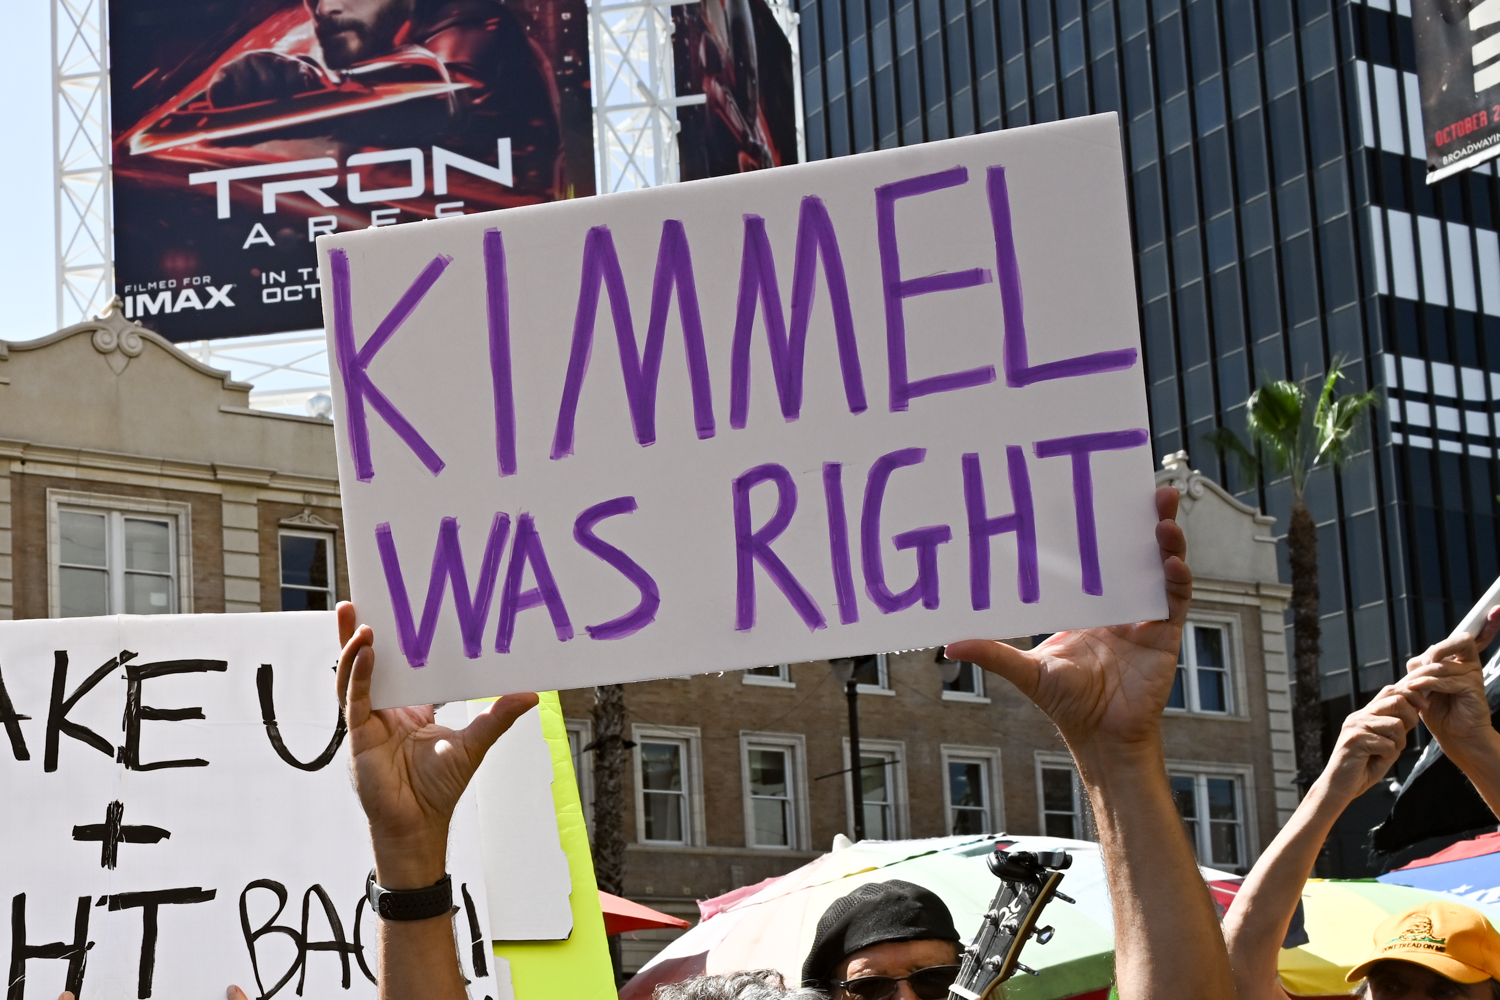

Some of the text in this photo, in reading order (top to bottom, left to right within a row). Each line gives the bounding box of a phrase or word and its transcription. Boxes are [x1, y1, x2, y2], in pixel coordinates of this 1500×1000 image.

[1435, 110, 1489, 147] OCTOBER
[189, 137, 514, 219] TRON
[124, 275, 212, 293] FILMED FOR
[124, 284, 237, 318] IMAX
[261, 270, 286, 285] IN
[326, 164, 1137, 483] KIMMEL
[375, 428, 1148, 669] WAS RIGHT
[71, 799, 172, 870] +
